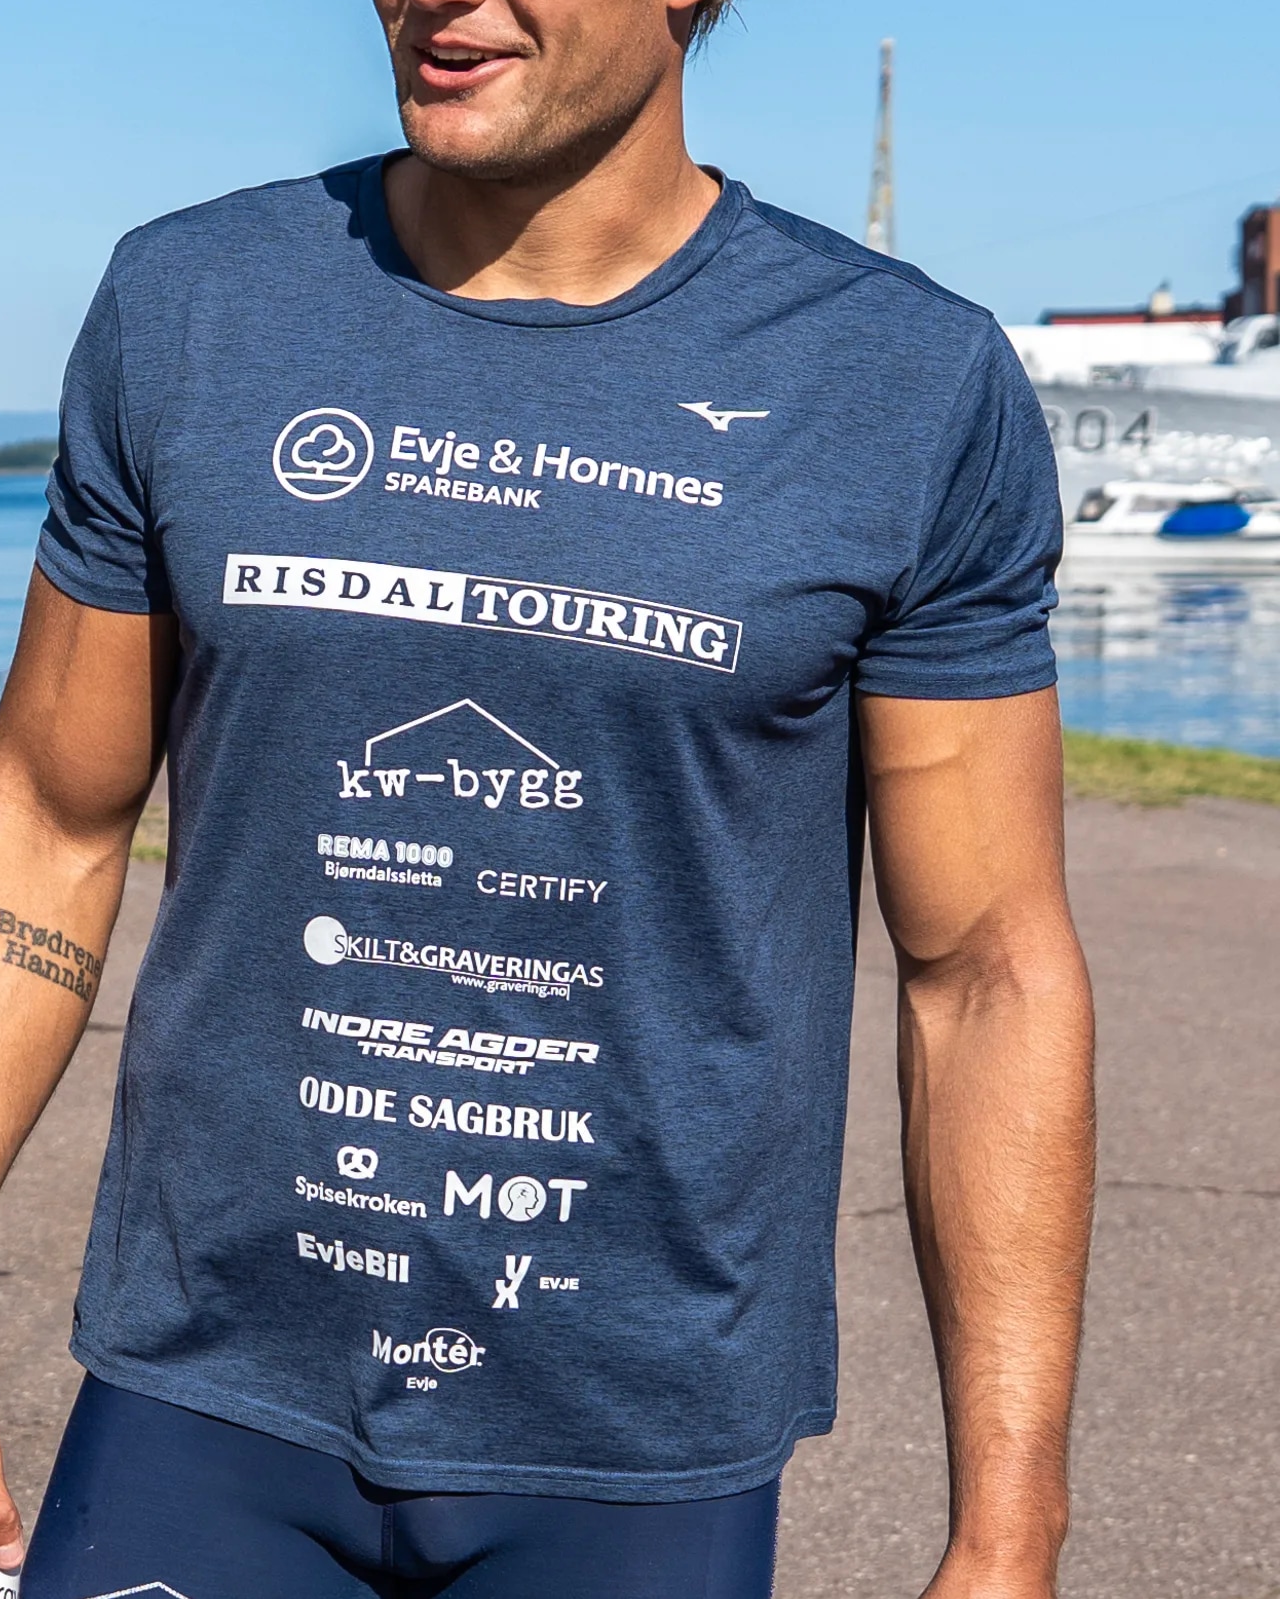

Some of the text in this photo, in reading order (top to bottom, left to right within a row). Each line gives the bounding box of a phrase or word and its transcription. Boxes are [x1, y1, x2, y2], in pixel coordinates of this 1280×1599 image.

[390, 425, 724, 508] Evje & Hornnes
[384, 471, 542, 509] SPAREBANK
[234, 564, 730, 663] RISDAL TOURING
[336, 758, 584, 809] kw-bygg
[317, 833, 454, 868] REMA 1000
[324, 860, 442, 887] Bjørndalssletta
[476, 869, 608, 903] CERTIFY
[451, 974, 567, 998] www.gravering.no
[301, 1007, 600, 1064] INDRE AGDER
[357, 1040, 535, 1075] TRANSPORT
[299, 1076, 595, 1143] ODDE SAGBRUK
[294, 1175, 427, 1218] Spisekroken
[443, 1170, 588, 1222] MOT
[296, 1232, 409, 1283] EvjeBil
[539, 1277, 579, 1290] EVJE
[406, 1377, 438, 1391] Evje
